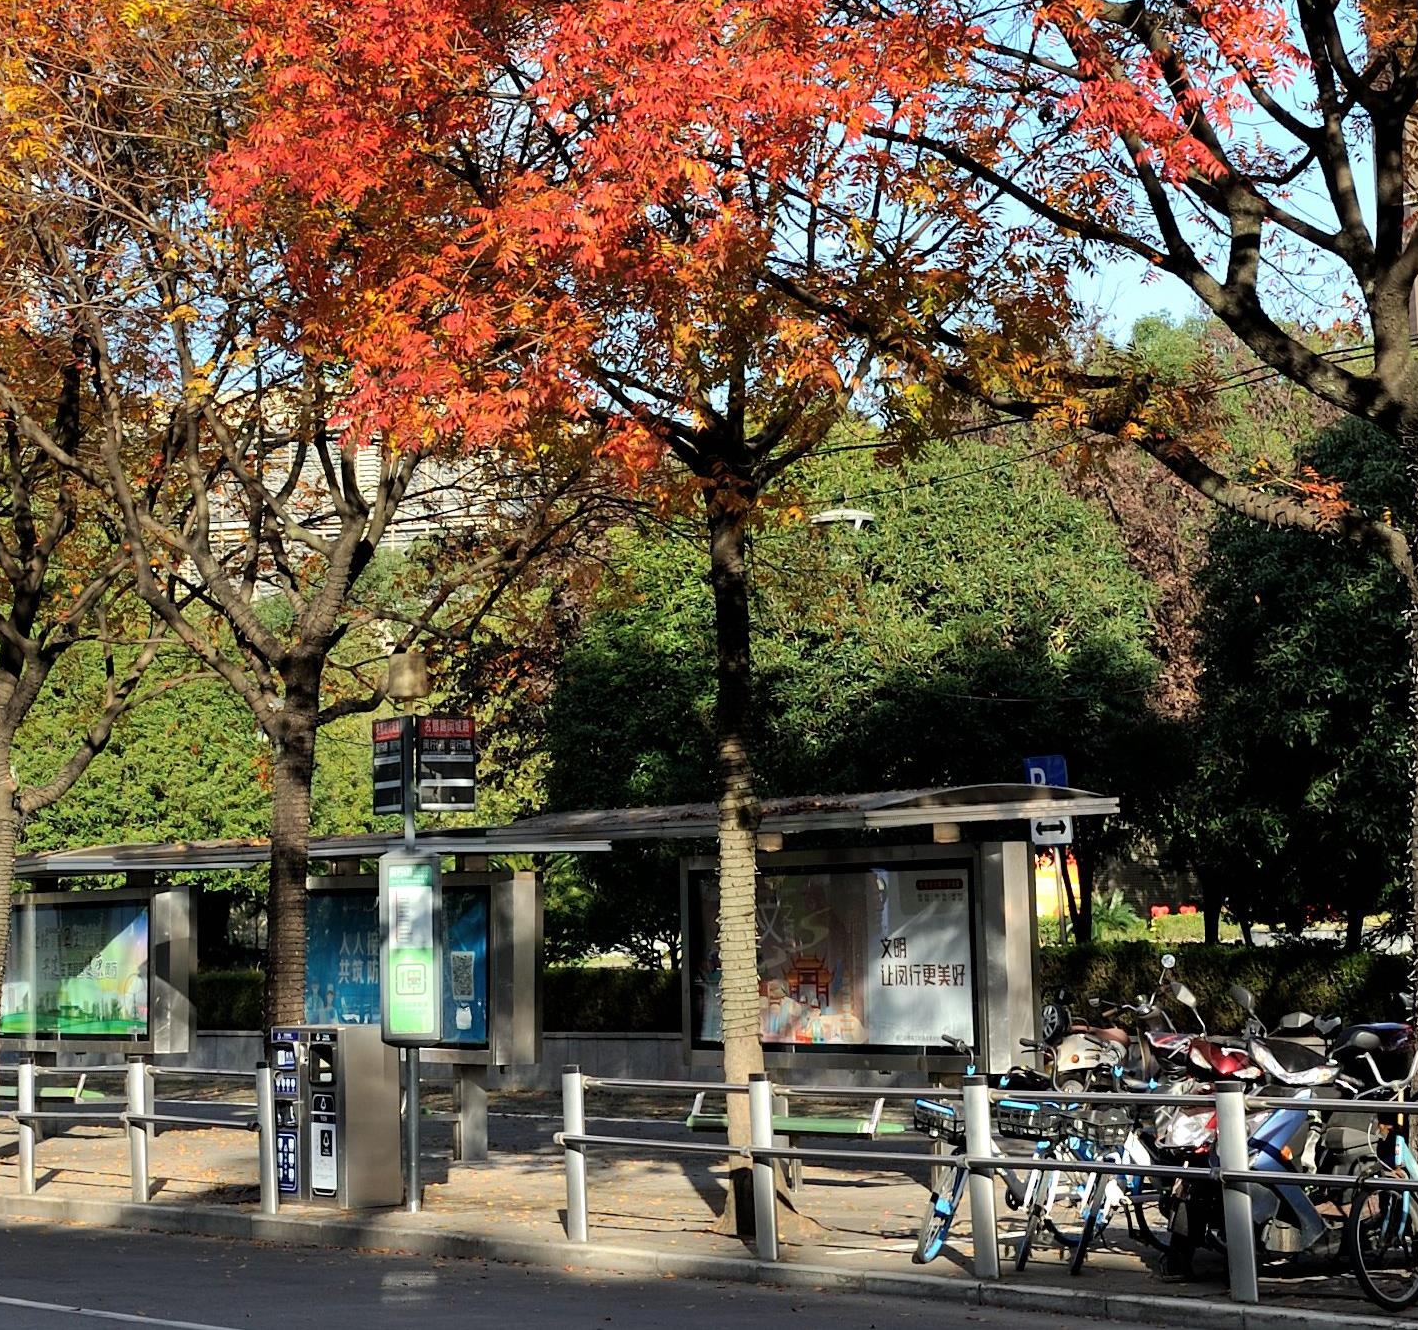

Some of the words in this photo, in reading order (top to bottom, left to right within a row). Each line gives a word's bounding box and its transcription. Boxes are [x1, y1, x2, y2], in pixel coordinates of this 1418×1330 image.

[880, 937, 907, 958] 文明
[881, 964, 966, 986] 让闵行更美好
